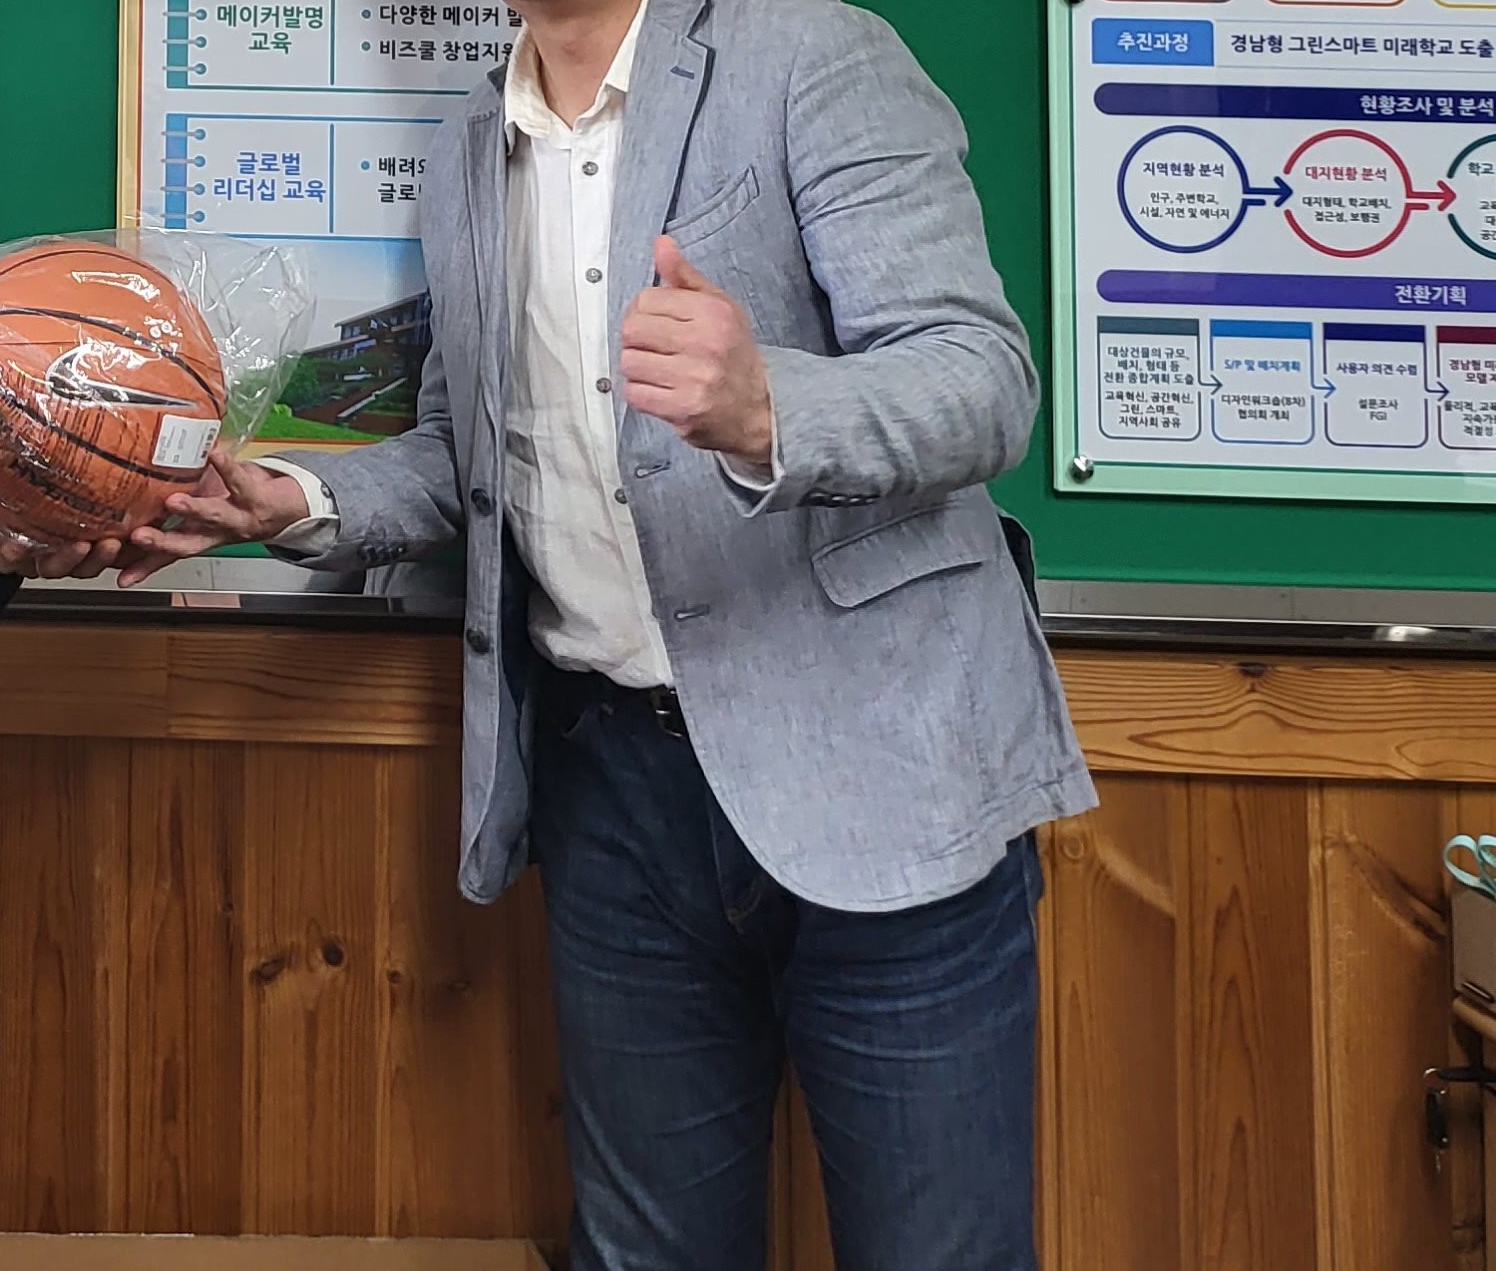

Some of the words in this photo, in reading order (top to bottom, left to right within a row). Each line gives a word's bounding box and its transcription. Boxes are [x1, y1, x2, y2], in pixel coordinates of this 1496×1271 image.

[216, 5, 323, 30] 메이커발명
[379, 4, 437, 25] 다양한
[443, 6, 499, 26] 메이커
[248, 31, 291, 54] 교육
[379, 40, 436, 60] 비즈쿨
[1118, 33, 1188, 52] 추진과정
[1231, 35, 1283, 54] 경남형
[1459, 41, 1494, 57] 도출
[1360, 95, 1432, 115] 현황조사
[1437, 98, 1453, 115] 및
[237, 152, 302, 176] 글로벌
[1143, 163, 1195, 176] 지역현황
[1199, 163, 1224, 177] 분석
[1305, 167, 1357, 180] 대지현황
[1361, 168, 1387, 181] 분석
[213, 178, 278, 202] 리더십
[283, 179, 326, 202] 교육
[1395, 286, 1467, 305] 전환기획
